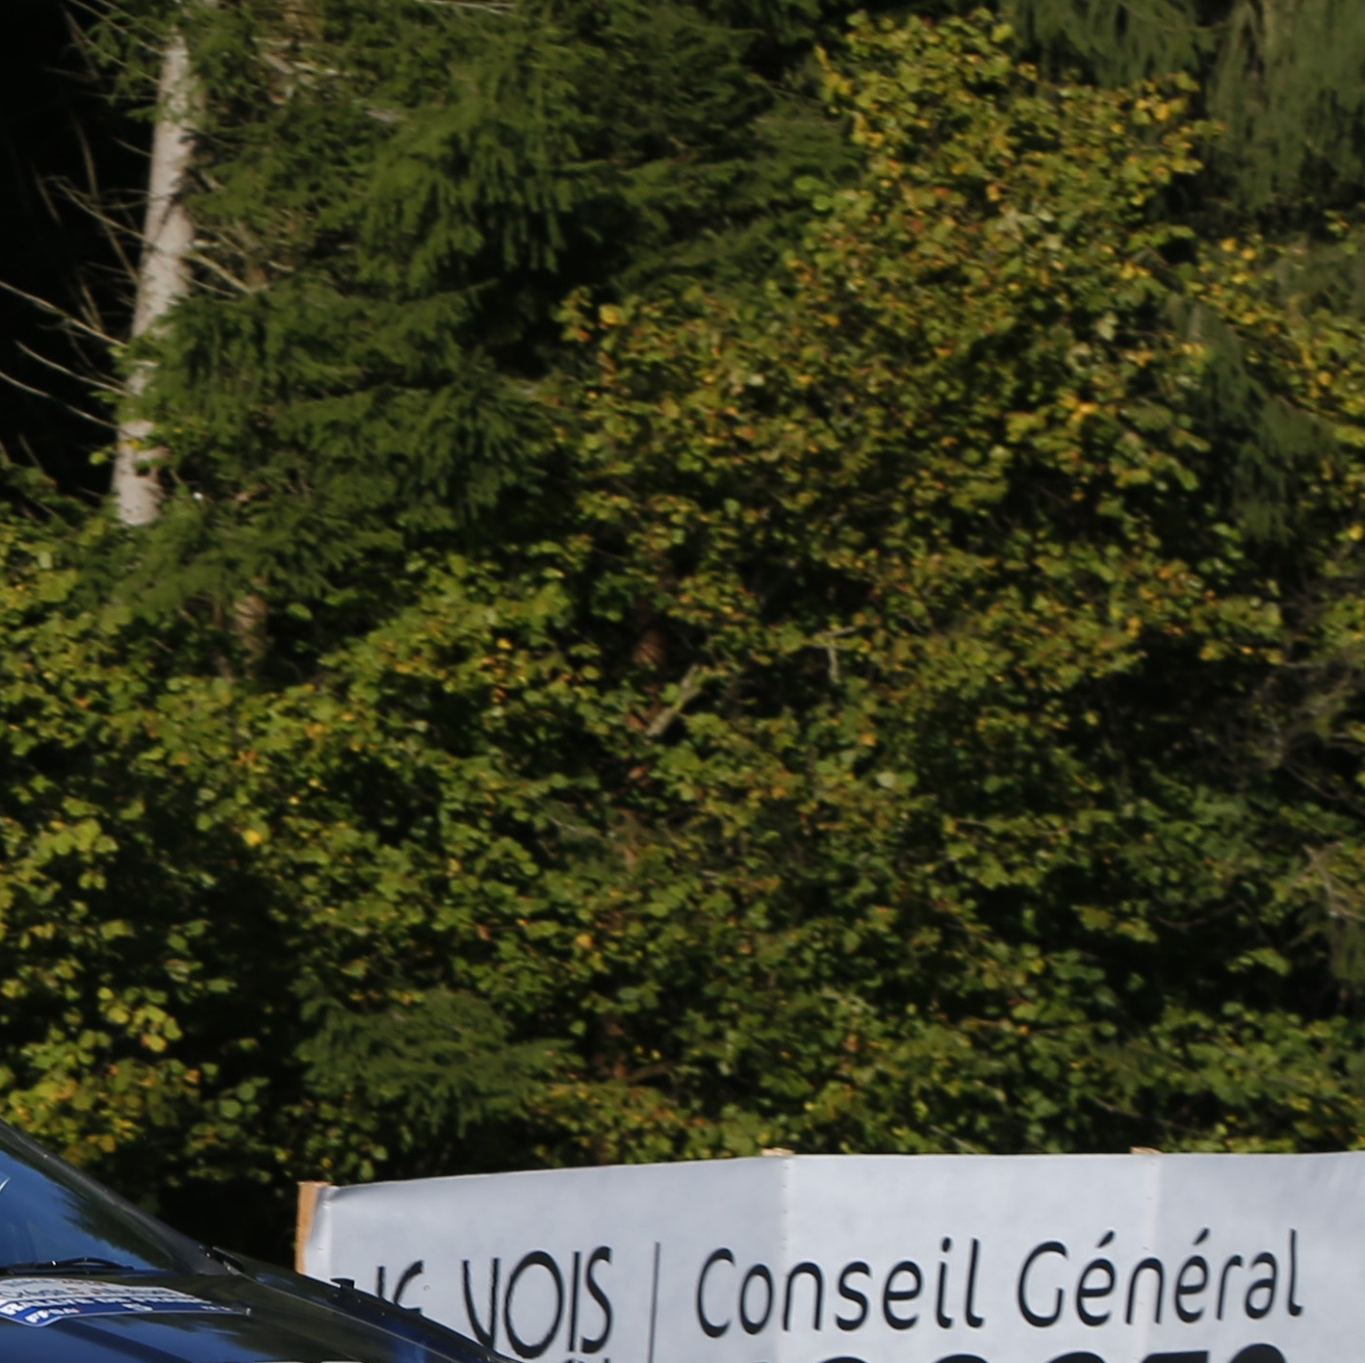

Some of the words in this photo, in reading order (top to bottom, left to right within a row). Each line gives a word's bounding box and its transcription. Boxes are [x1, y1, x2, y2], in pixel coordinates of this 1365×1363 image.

[461, 1246, 614, 1360] VOIS
[696, 1236, 986, 1340] Conseil
[1015, 1228, 1305, 1328] Général
